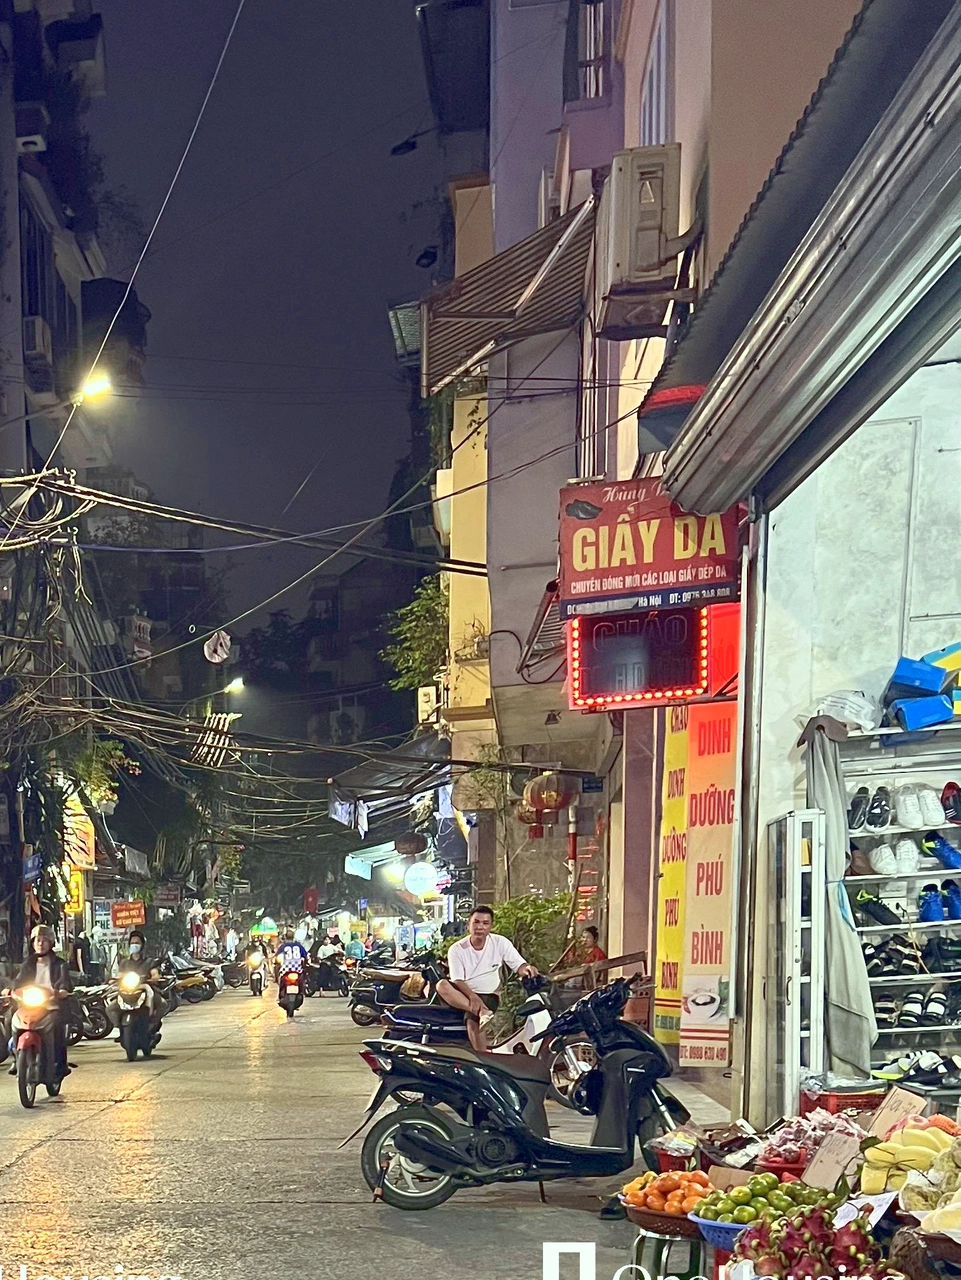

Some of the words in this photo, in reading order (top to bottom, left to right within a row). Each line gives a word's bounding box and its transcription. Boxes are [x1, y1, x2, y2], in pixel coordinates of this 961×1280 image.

[602, 485, 651, 507] Hùng
[673, 512, 727, 560] DA
[570, 577, 601, 594] CHUYÊN
[642, 570, 658, 586] CÁC
[660, 570, 677, 586] LOẠI
[698, 564, 713, 580] DÉP
[716, 564, 727, 578] DA
[649, 595, 662, 608] Nội
[698, 718, 732, 756] DINH
[668, 767, 686, 799] DINH
[690, 783, 735, 828] DƯỠNG
[696, 854, 724, 896] PHÚ
[665, 891, 680, 927] PHÚ
[284, 945, 300, 960] 38
[691, 923, 724, 965] BÌNH
[661, 953, 679, 990] BÌNH
